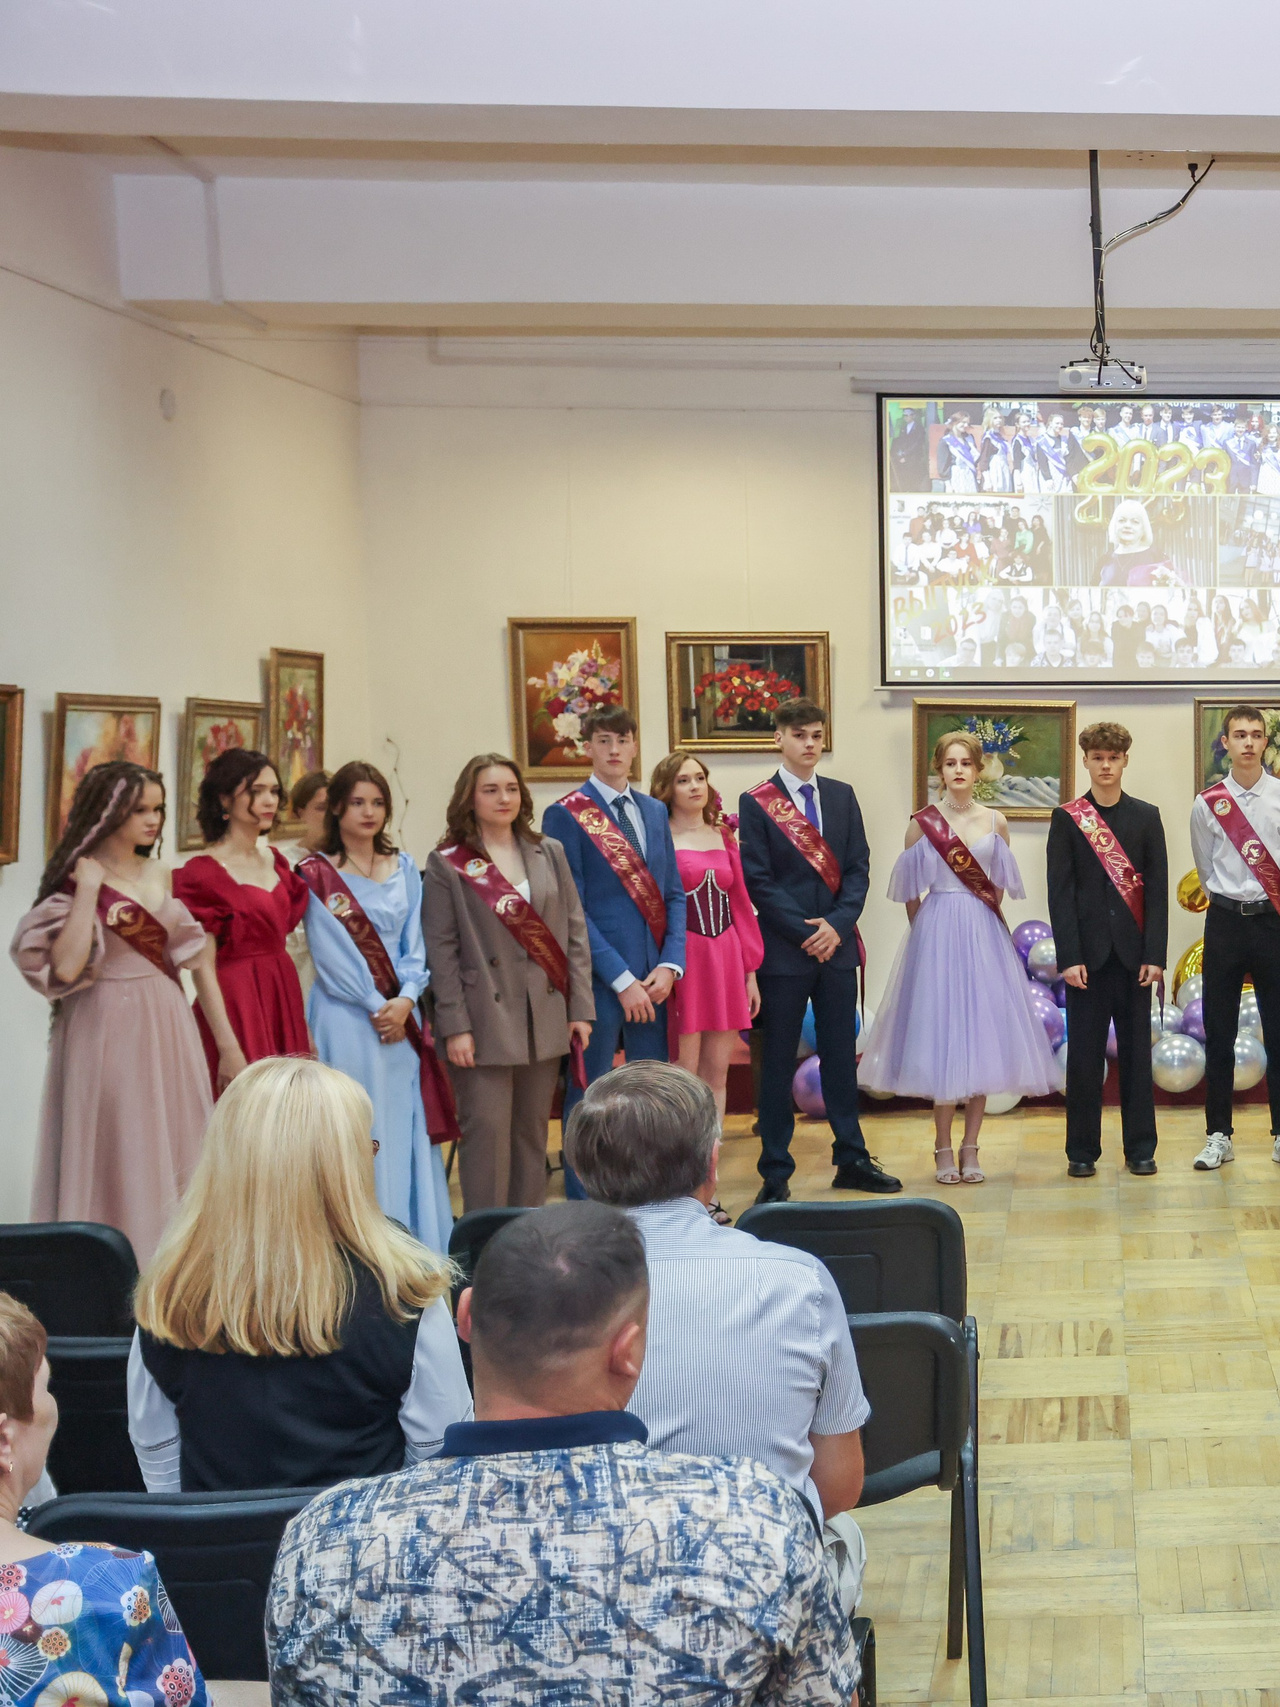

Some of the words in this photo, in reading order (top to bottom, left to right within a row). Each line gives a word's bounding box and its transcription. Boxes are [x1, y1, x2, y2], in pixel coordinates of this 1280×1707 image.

[1077, 431, 1231, 494] 2023
[894, 554, 998, 627] ВЫПУСК
[931, 602, 986, 645] 2023
